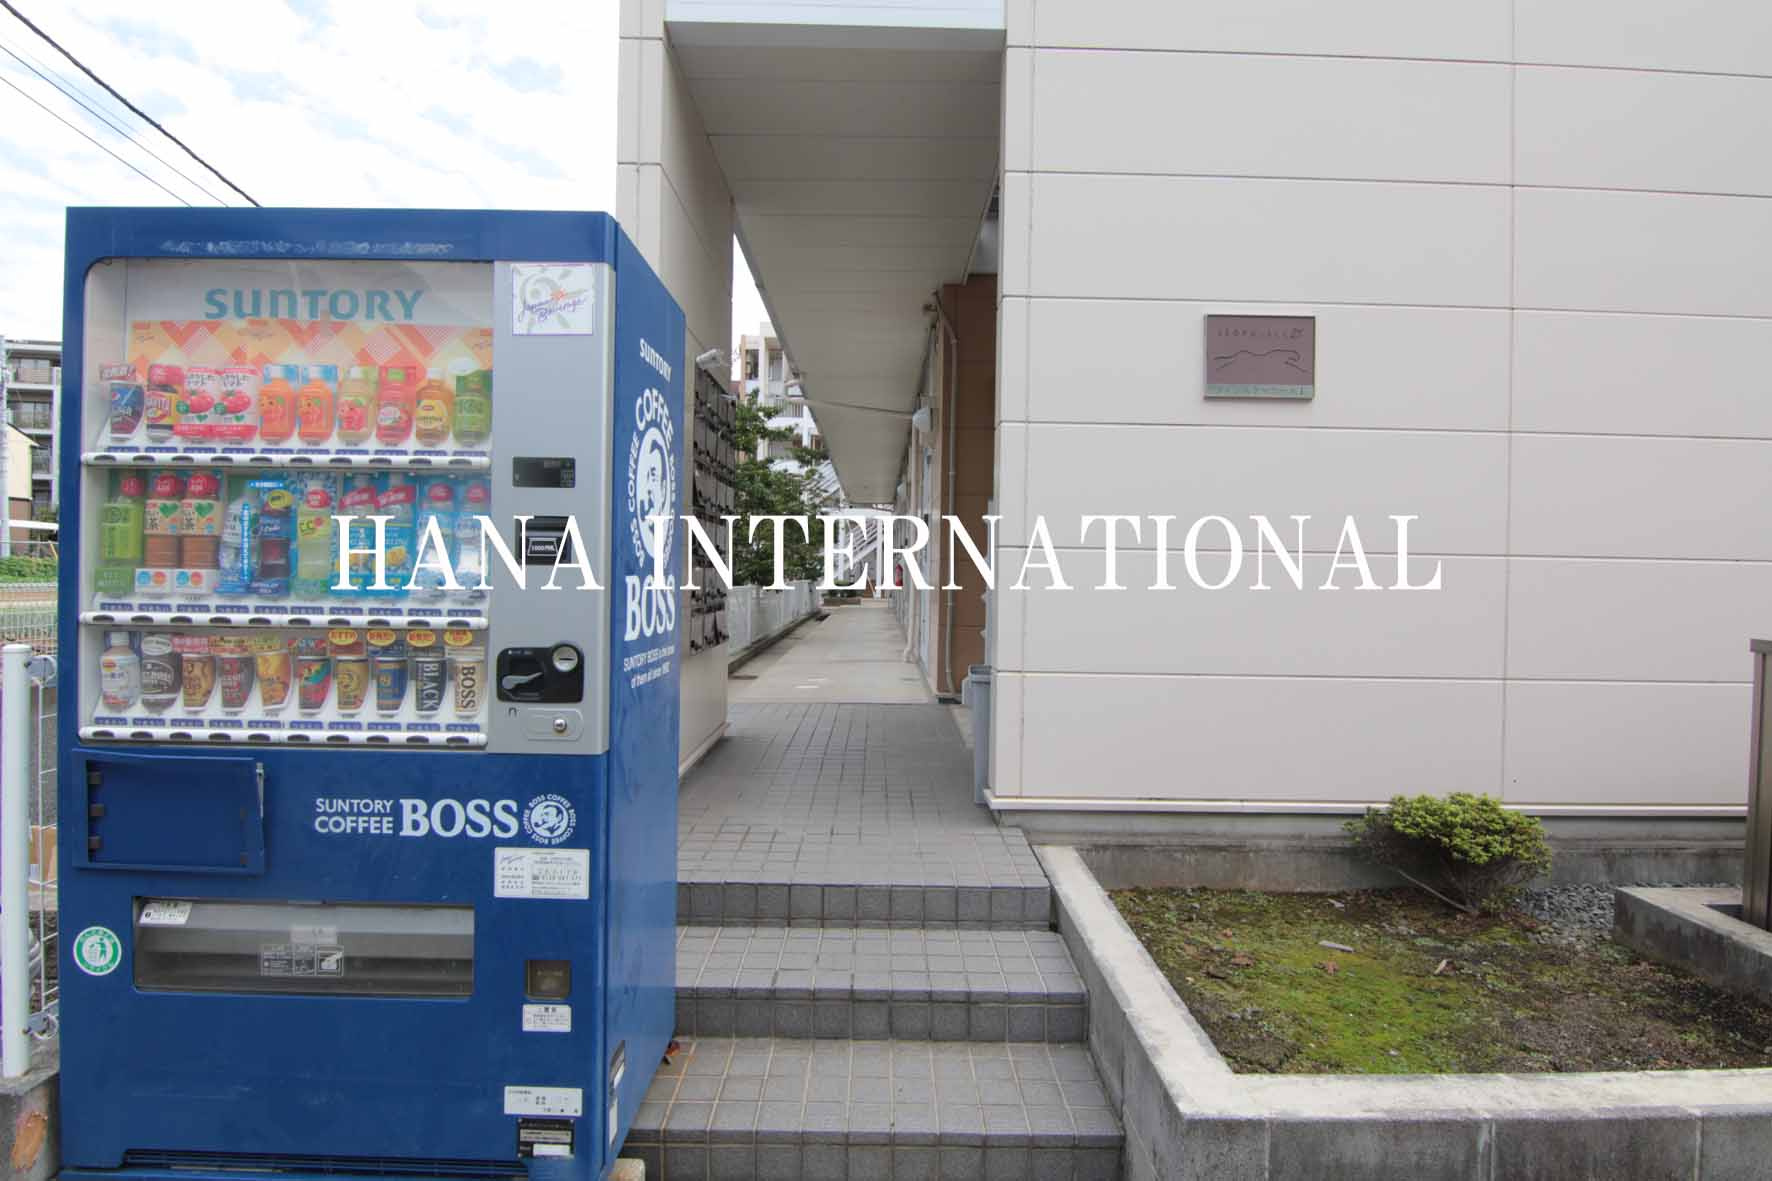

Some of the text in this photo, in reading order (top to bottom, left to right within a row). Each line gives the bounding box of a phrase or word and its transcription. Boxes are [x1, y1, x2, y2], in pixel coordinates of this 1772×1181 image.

[205, 287, 424, 321] SUNTORY
[639, 337, 673, 385] SUNTORY
[635, 386, 674, 451] COFFEE
[624, 574, 676, 642] BOSS
[423, 663, 440, 710] BLACK
[460, 666, 476, 709] BOSS
[315, 798, 394, 814] SUNTORY
[399, 798, 519, 838] BOSS
[528, 793, 572, 809] BOSS COFFEE
[315, 816, 394, 834] COFFEE
